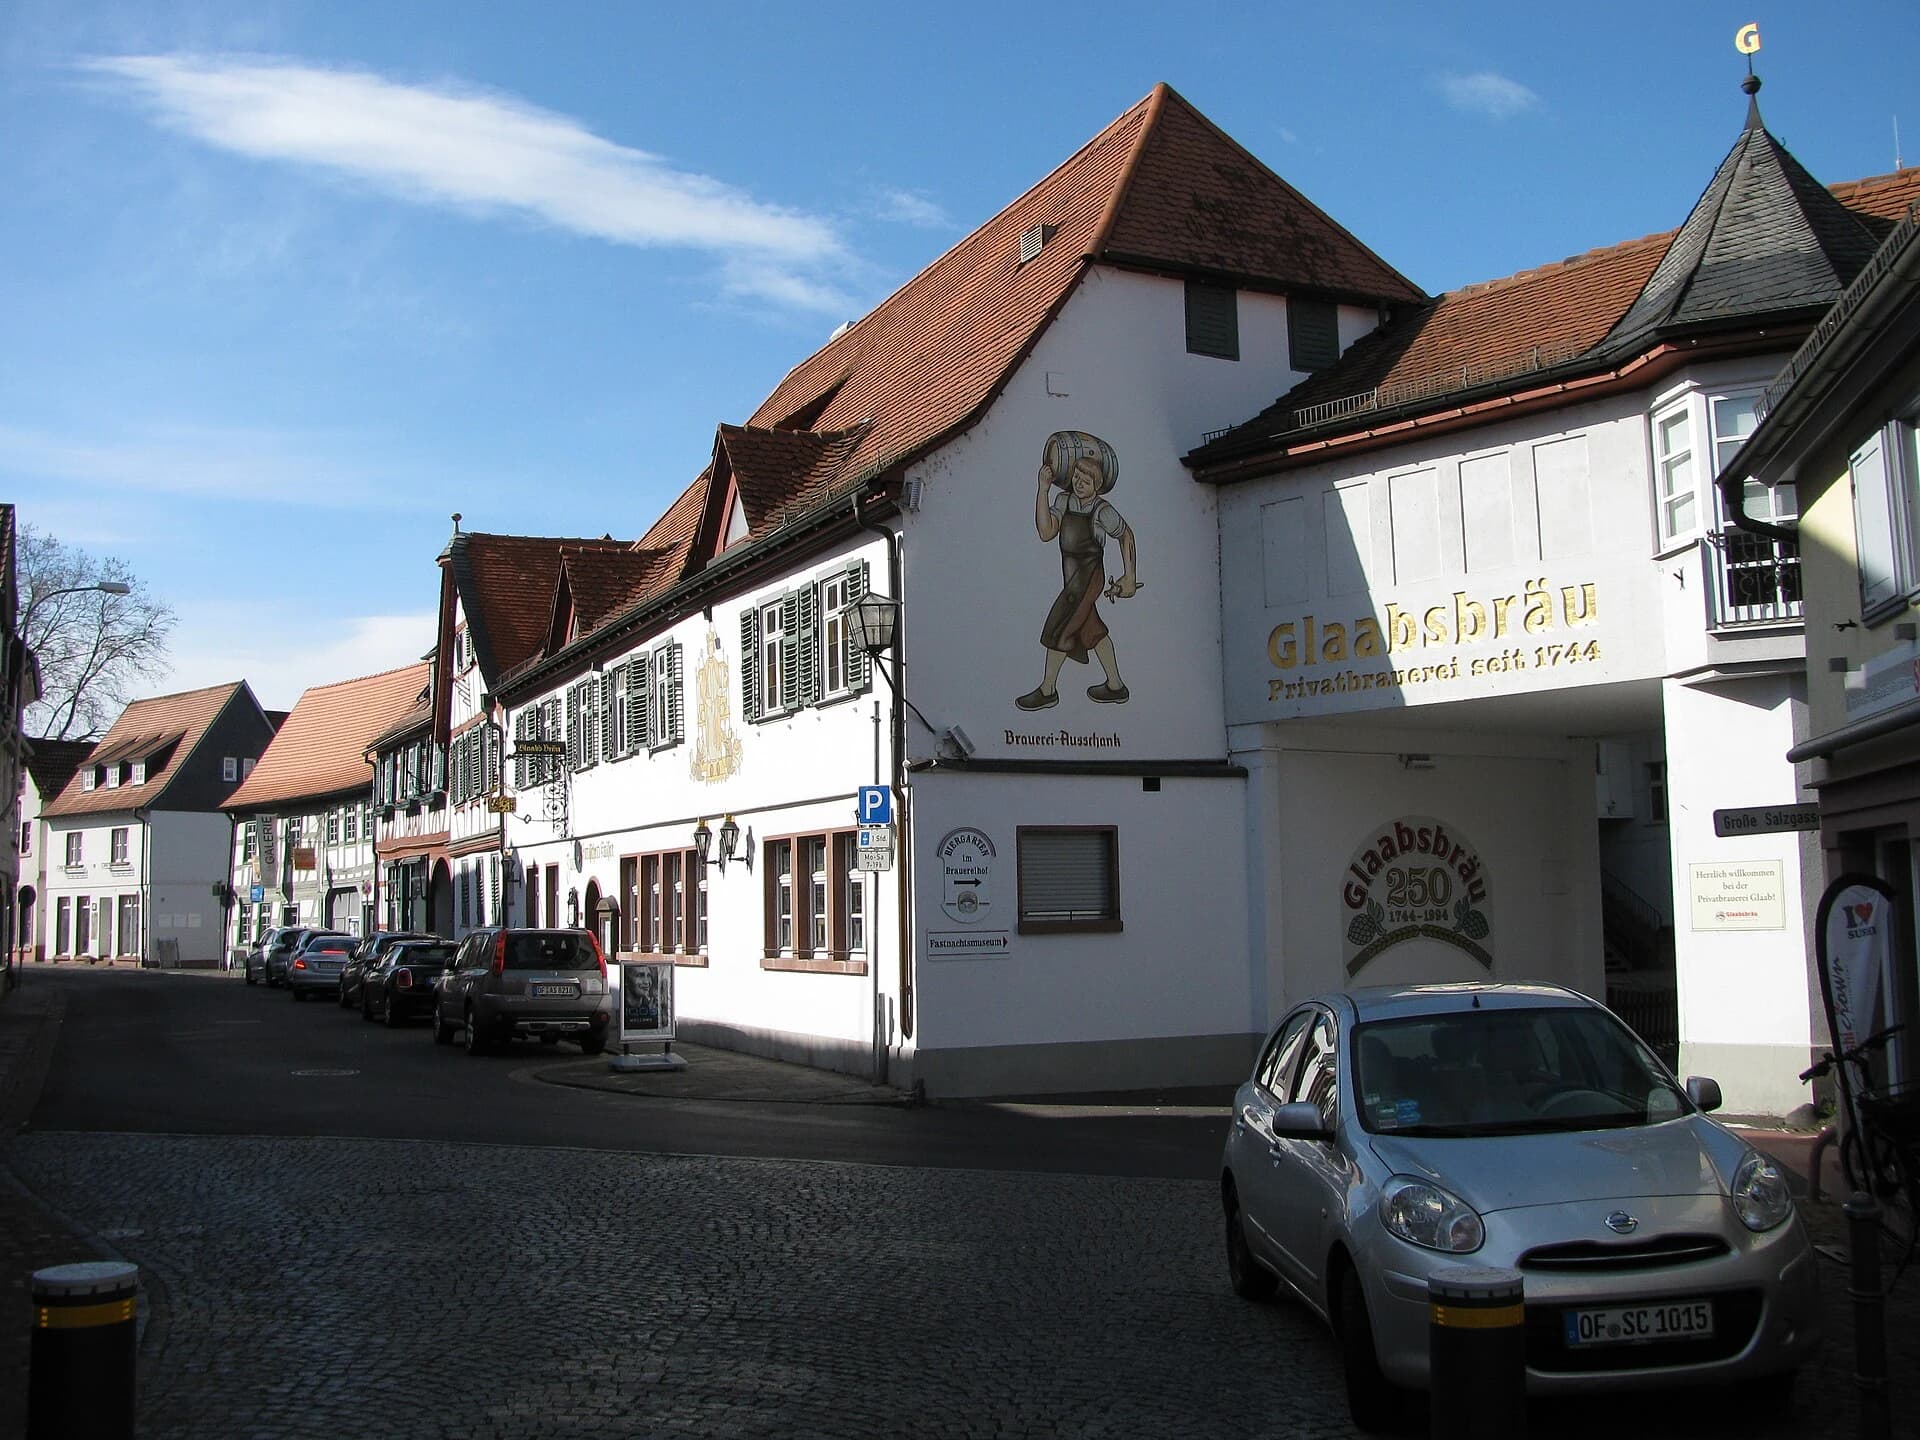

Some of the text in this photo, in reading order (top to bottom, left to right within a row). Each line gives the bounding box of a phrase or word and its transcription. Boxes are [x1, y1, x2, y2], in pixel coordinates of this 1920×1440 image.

[1736, 23, 1761, 54] G
[1267, 577, 1598, 669] Glaabsbräu
[1268, 639, 1602, 701] Privatbrauerei seit 1744
[1004, 730, 1121, 749] Brauerei-Ausschank
[866, 791, 883, 820] P
[1724, 811, 1819, 830] Große Salzgass
[262, 816, 275, 865] GALERIE
[945, 834, 990, 857] BIERGARTEN
[963, 854, 972, 863] im
[1344, 821, 1486, 909] Glaabsbräu
[945, 866, 989, 875] Brauereihof
[1696, 869, 1775, 879] Herzlich willkommen
[1386, 867, 1452, 908] 250
[1722, 881, 1748, 890] bei der
[1697, 893, 1776, 903] Privatbrauerei Glaab!
[930, 938, 1002, 949] Fastnachtsmuseum
[1580, 1313, 1606, 1339] OF
[1623, 1310, 1649, 1335] SC
[1655, 1306, 1707, 1333] 1015
